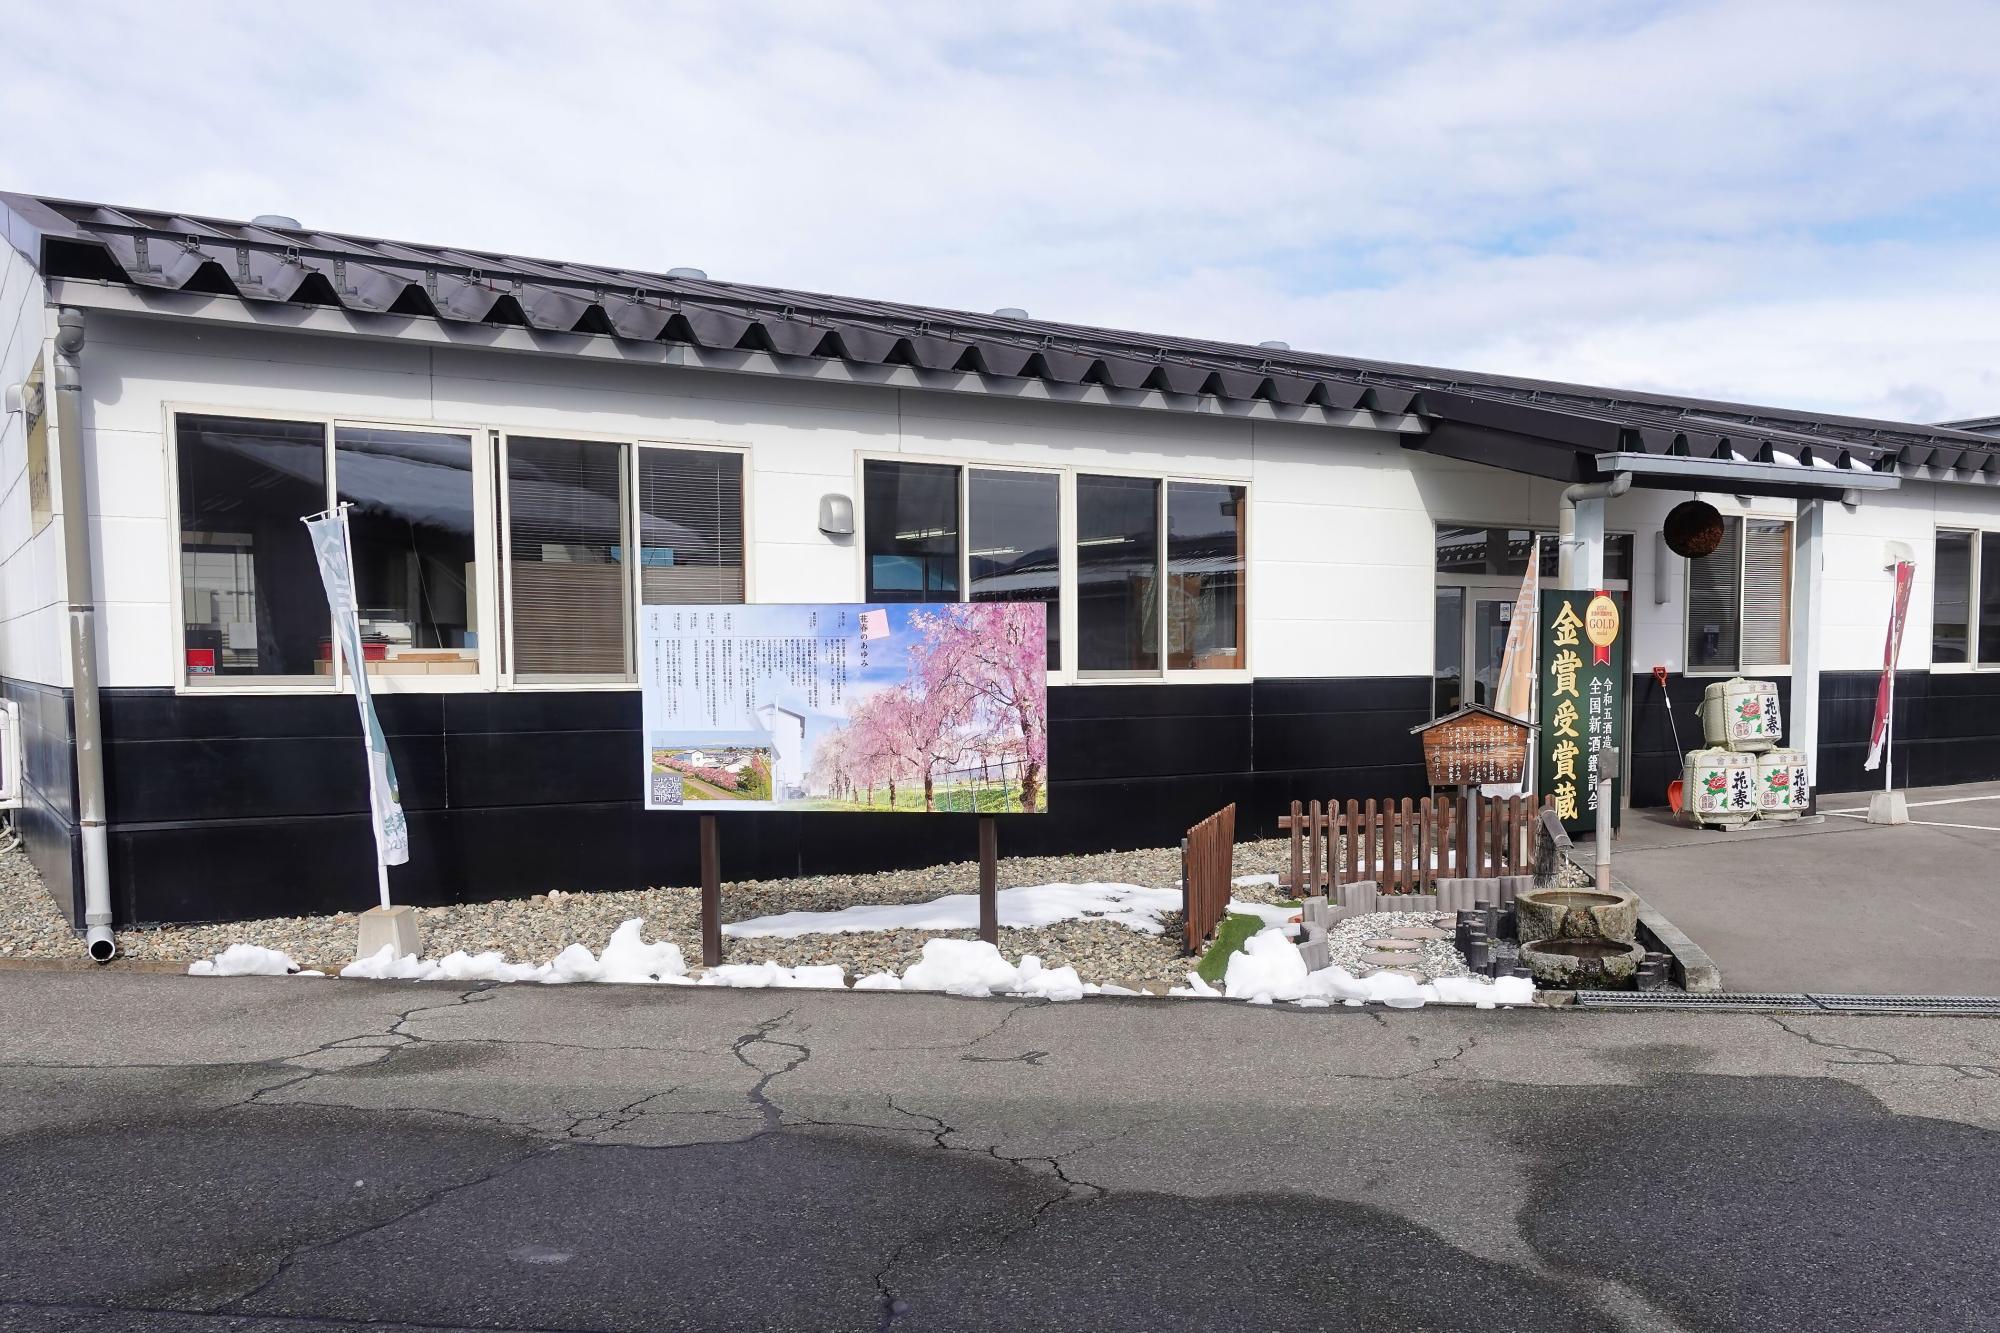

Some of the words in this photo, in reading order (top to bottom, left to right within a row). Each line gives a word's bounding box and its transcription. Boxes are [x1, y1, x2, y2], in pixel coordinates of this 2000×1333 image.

[859, 614, 869, 668] 花春のあゆみ
[1589, 618, 1615, 629] GOLD
[1550, 600, 1584, 820] 金賞受賞蔵
[1764, 696, 1780, 734] 花春
[1731, 770, 1750, 809] 花春
[1792, 768, 1807, 806] 花春
